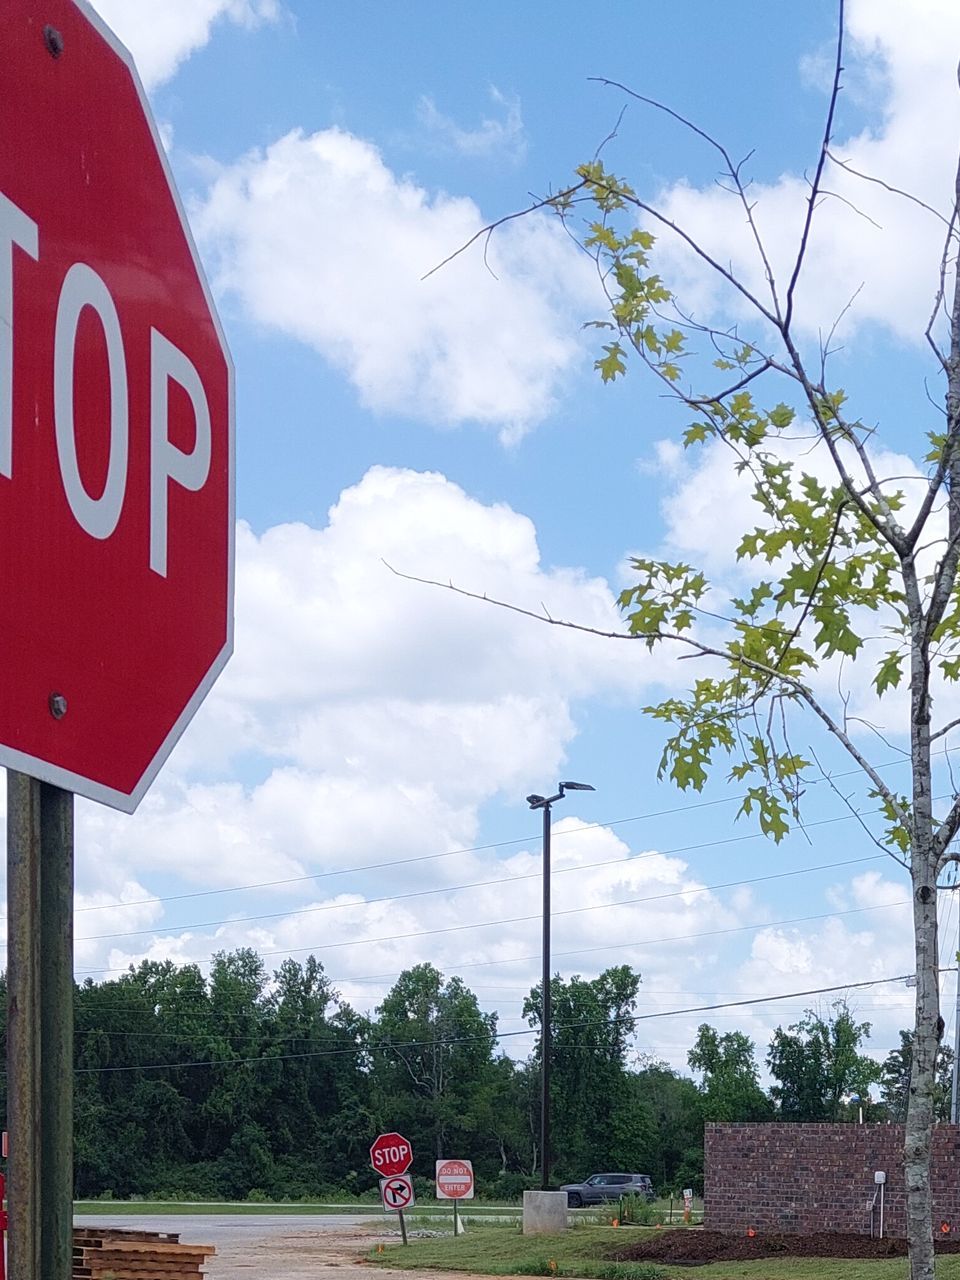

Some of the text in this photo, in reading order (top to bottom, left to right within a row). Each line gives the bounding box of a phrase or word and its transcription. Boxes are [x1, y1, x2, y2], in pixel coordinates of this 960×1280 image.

[374, 1145, 408, 1166] STOP
[441, 1167, 468, 1175] DO NOT
